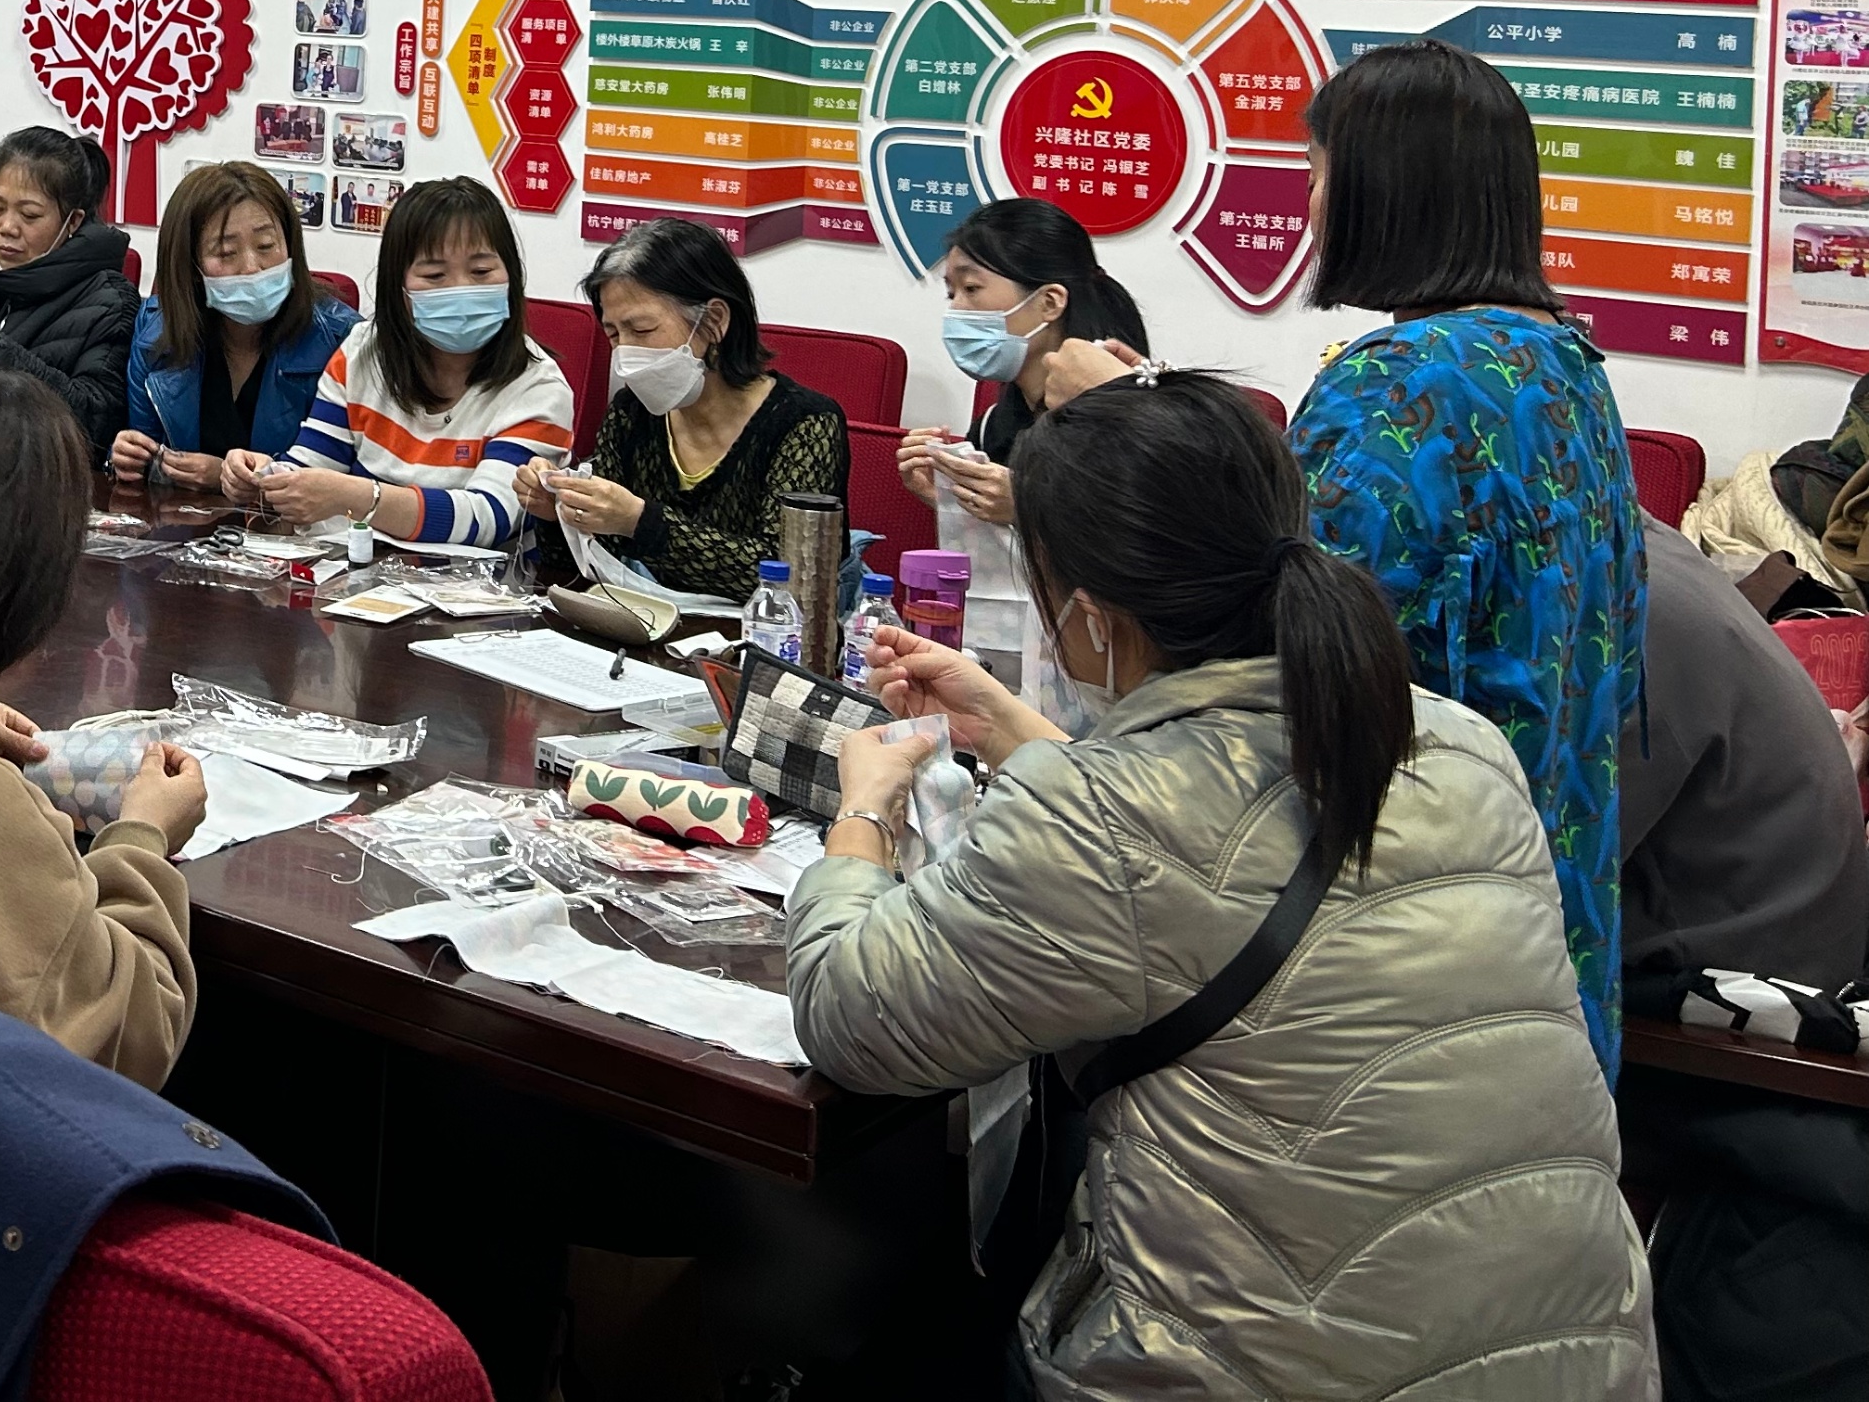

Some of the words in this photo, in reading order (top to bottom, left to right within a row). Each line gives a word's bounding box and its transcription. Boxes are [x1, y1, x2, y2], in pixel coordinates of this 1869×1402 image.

[521, 17, 567, 31] 服务项目
[829, 20, 875, 34] 非公企业
[1487, 24, 1562, 42] 公平小学
[399, 27, 414, 90] 工作宗旨
[483, 47, 497, 78] 制度
[820, 57, 866, 71] 非公企业
[905, 58, 977, 77] 第二党支部
[918, 79, 962, 96] 白增林
[1218, 71, 1302, 91] 第五党支部
[421, 67, 437, 129] 互联互动
[529, 89, 553, 102] 资源
[706, 84, 747, 100] 张伟明
[1676, 91, 1738, 110] 王楠楠
[528, 105, 552, 118] 清单
[812, 96, 858, 111] 非公企业
[1234, 94, 1284, 112] 金淑芳
[591, 121, 654, 140] 鸿利大药房
[703, 131, 743, 148] 高桂芝
[1034, 126, 1151, 151] 兴隆社区党委
[810, 137, 856, 152] 非公企业
[1536, 140, 1580, 159] 儿园
[526, 160, 550, 173] 需求
[1033, 153, 1095, 172] 党委书记
[1102, 158, 1151, 176] 冯银芝
[525, 177, 549, 191] 清单
[813, 177, 858, 193] 非公企业
[897, 177, 970, 197] 第一党支部
[819, 216, 865, 232] 非公企业
[1218, 211, 1304, 233] 第六党支部
[1674, 205, 1734, 226] 马铭悦
[1235, 234, 1285, 252] 王福所
